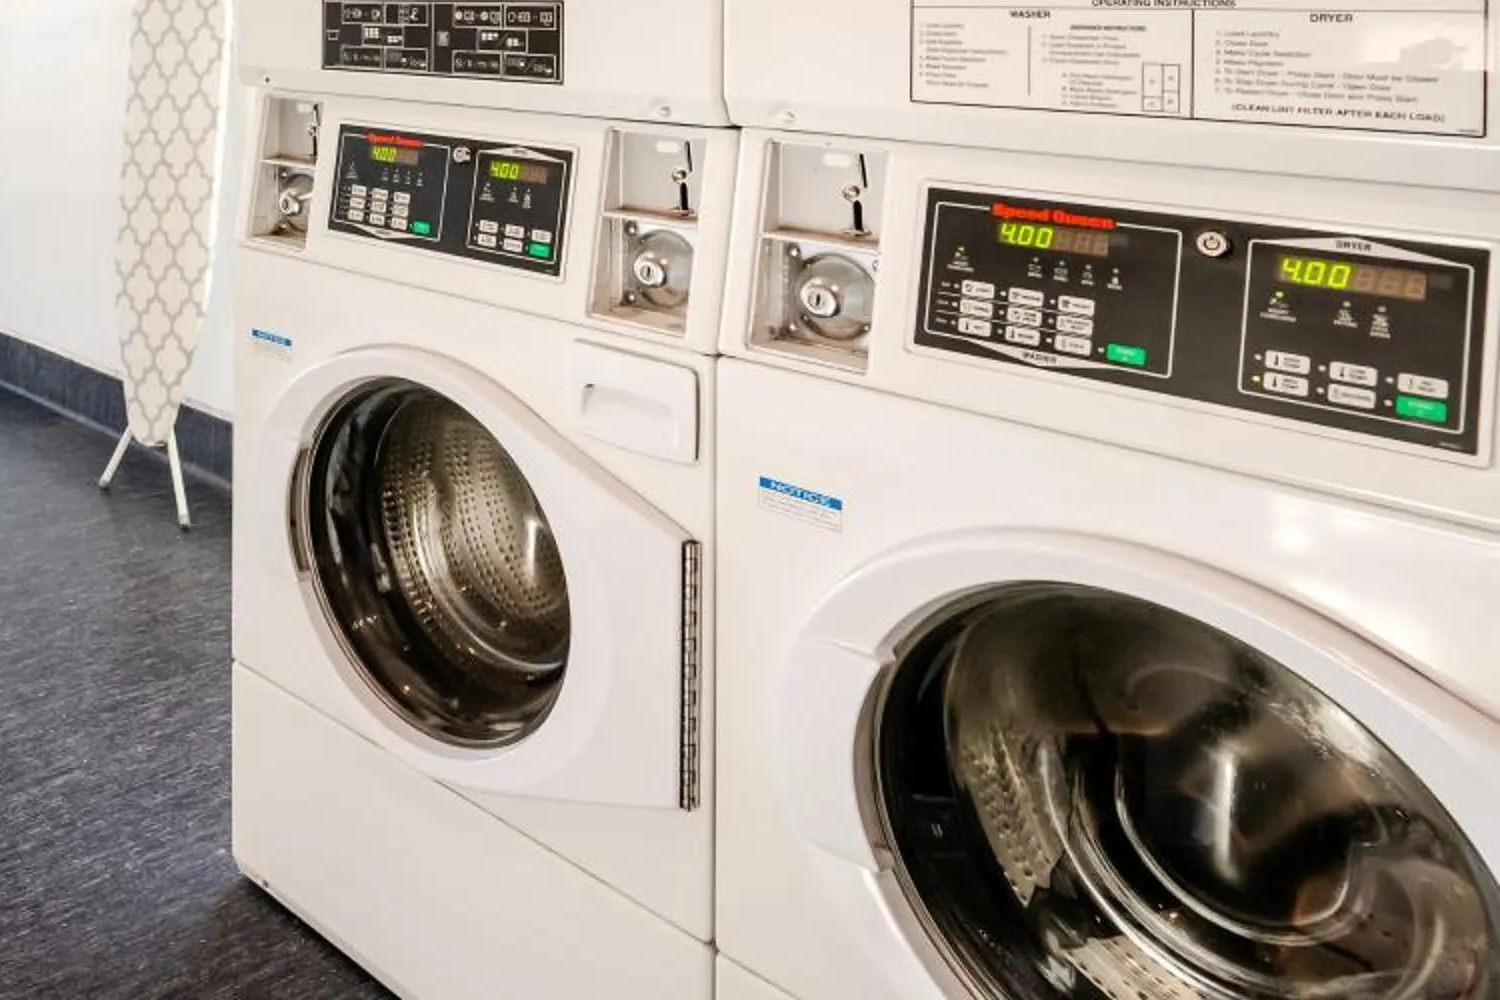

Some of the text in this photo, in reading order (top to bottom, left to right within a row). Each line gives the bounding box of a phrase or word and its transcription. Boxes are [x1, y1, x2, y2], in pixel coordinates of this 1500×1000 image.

[1009, 9, 1051, 19] WASHER
[1309, 13, 1353, 23] DRYER
[1298, 106, 1333, 115] FILTER
[1336, 109, 1372, 118] AFTER
[1375, 111, 1406, 121] EACH
[991, 202, 1116, 230] Speed Queen
[1001, 223, 1054, 249] 4.00
[1282, 258, 1351, 290] 4.00
[770, 480, 829, 506] NOTICE
